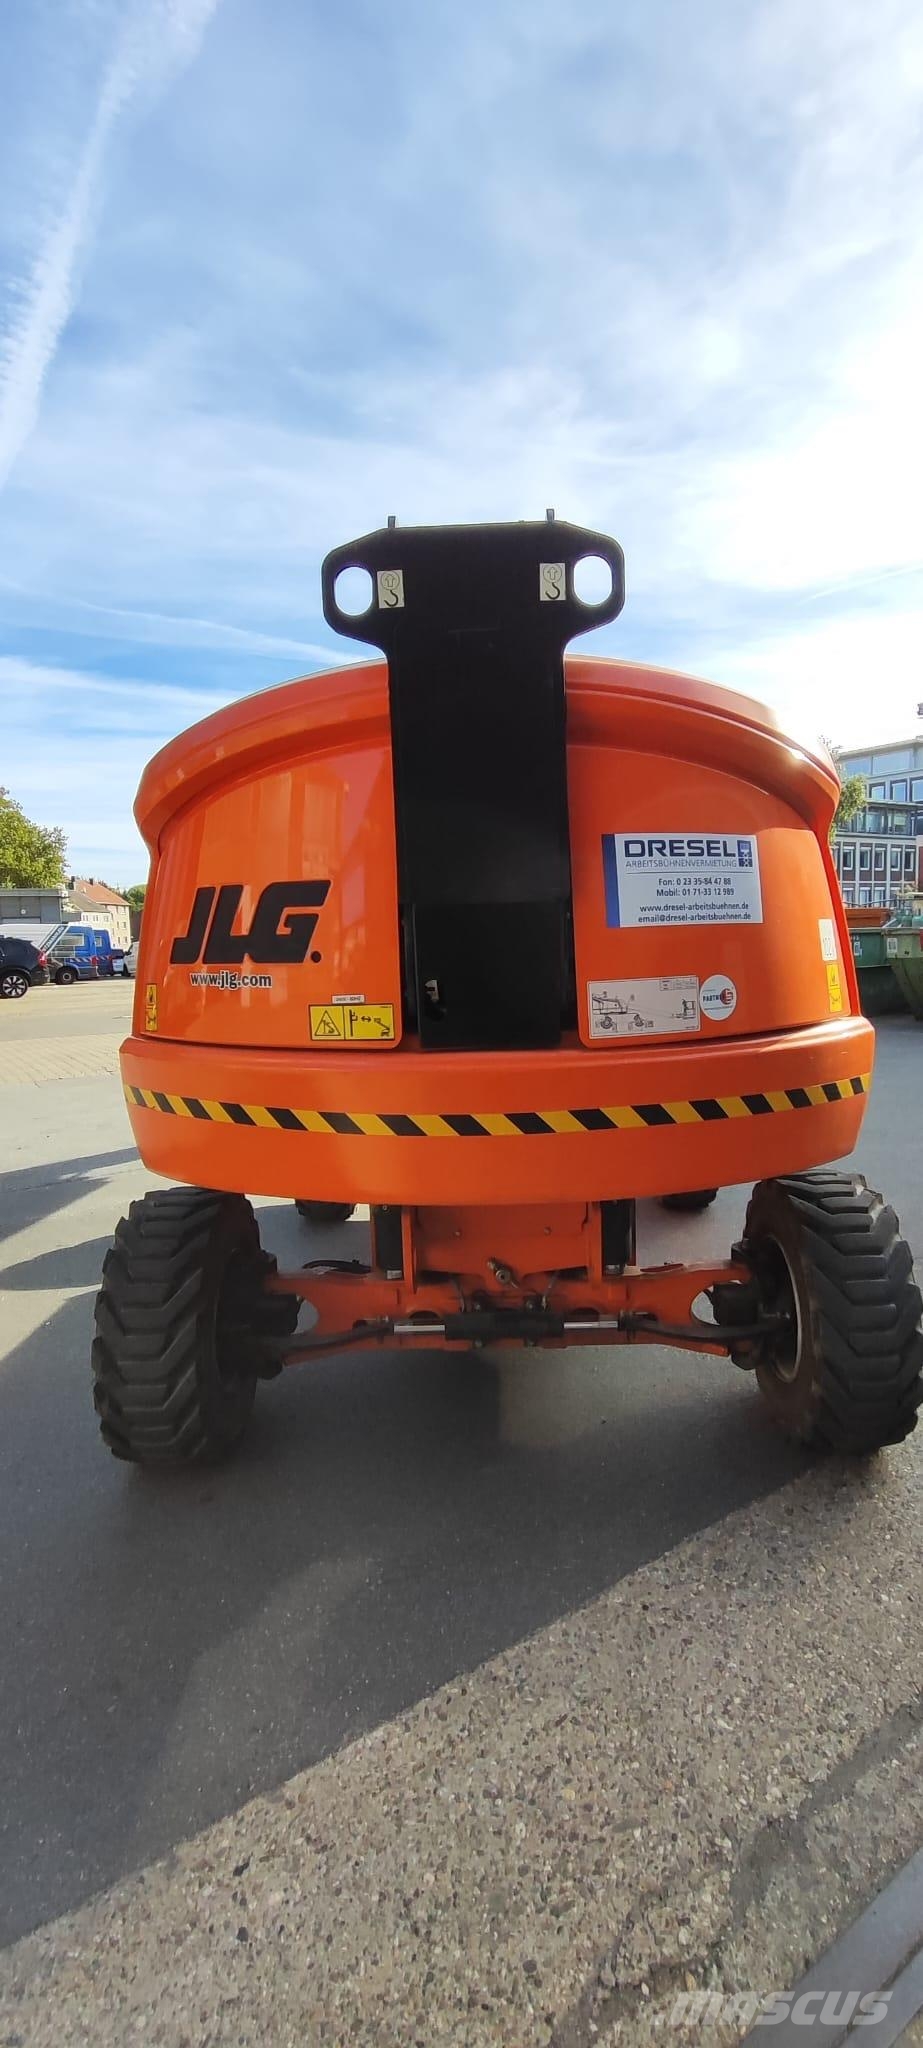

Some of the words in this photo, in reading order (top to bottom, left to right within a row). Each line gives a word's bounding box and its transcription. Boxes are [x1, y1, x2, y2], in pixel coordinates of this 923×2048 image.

[624, 839, 737, 857] DRESEL
[658, 878, 675, 886] Fon:
[714, 877, 722, 885] 47
[682, 888, 691, 896] 01
[693, 887, 712, 896] 71-33
[714, 887, 721, 896] 12
[191, 971, 272, 989] www.jlg.com
